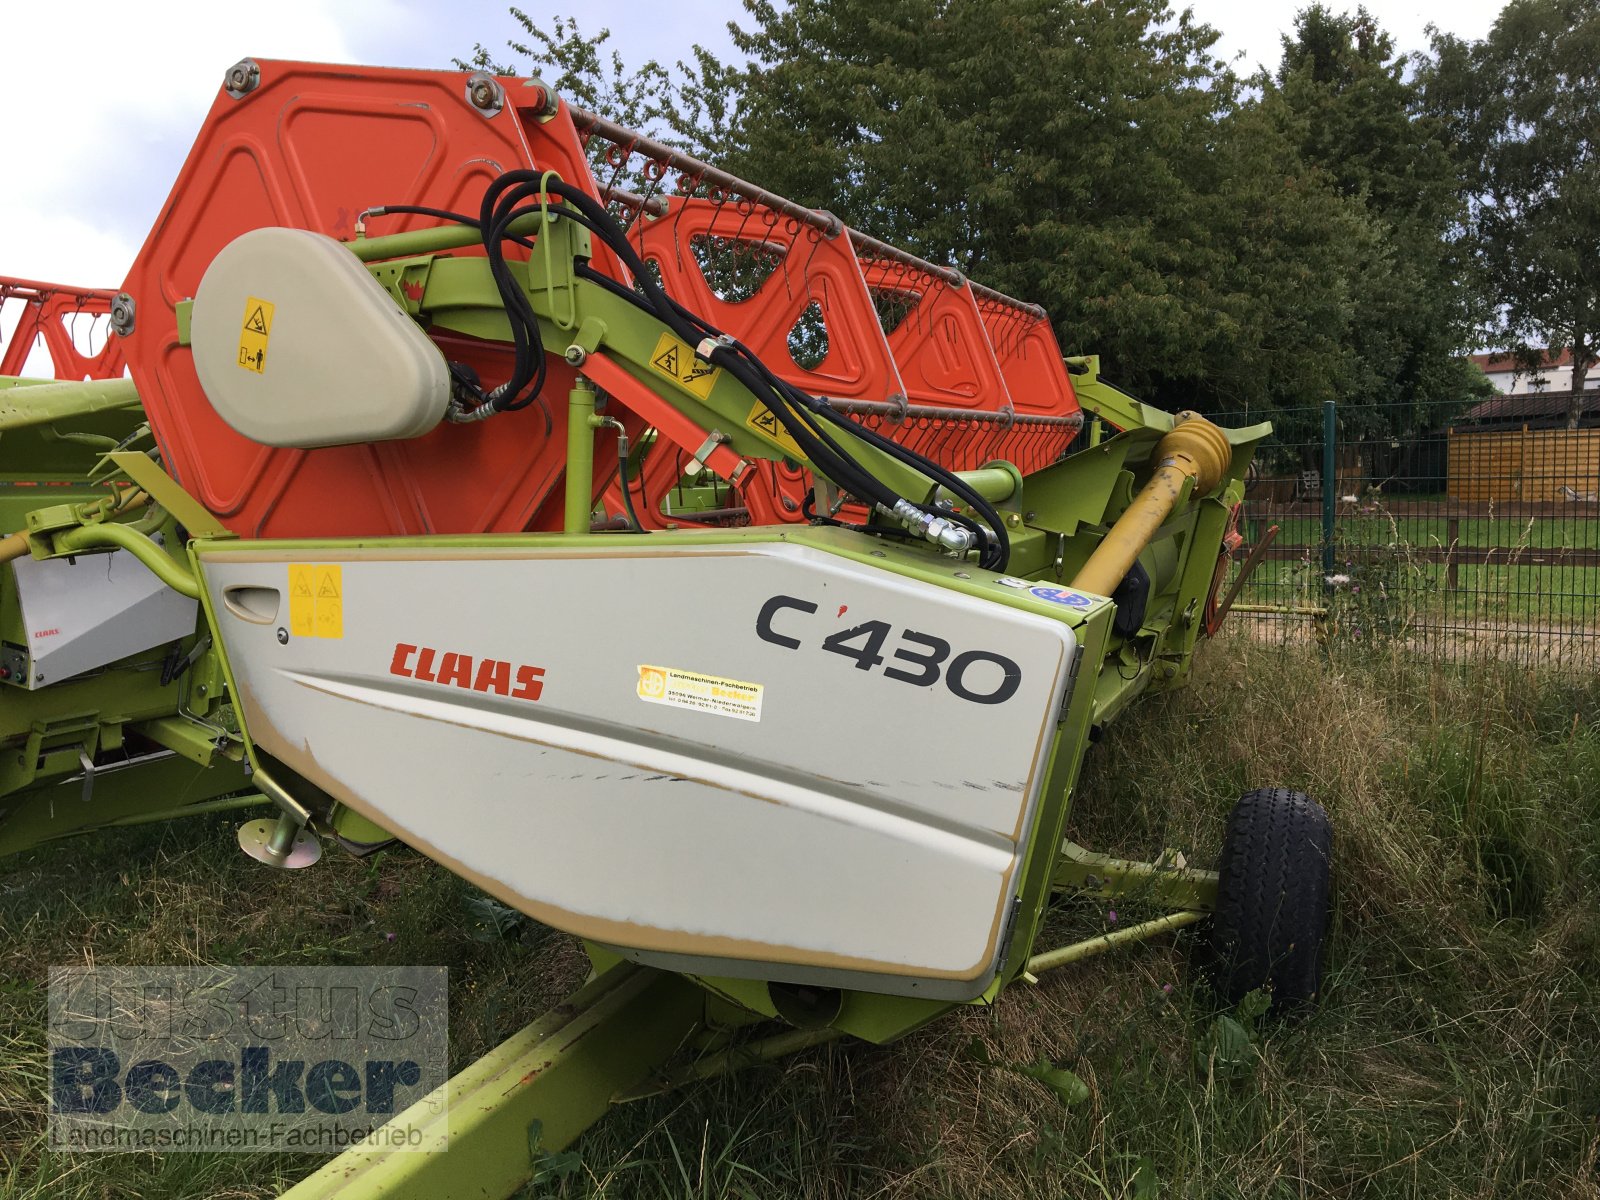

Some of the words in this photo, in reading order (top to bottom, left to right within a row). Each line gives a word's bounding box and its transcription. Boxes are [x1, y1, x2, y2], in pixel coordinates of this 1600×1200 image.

[35, 628, 60, 639] CLAAS
[755, 595, 818, 650] C
[821, 619, 1022, 704] 430
[390, 643, 546, 701] CLAAS
[669, 672, 758, 693] Landmaschinen-Fachbetrieb
